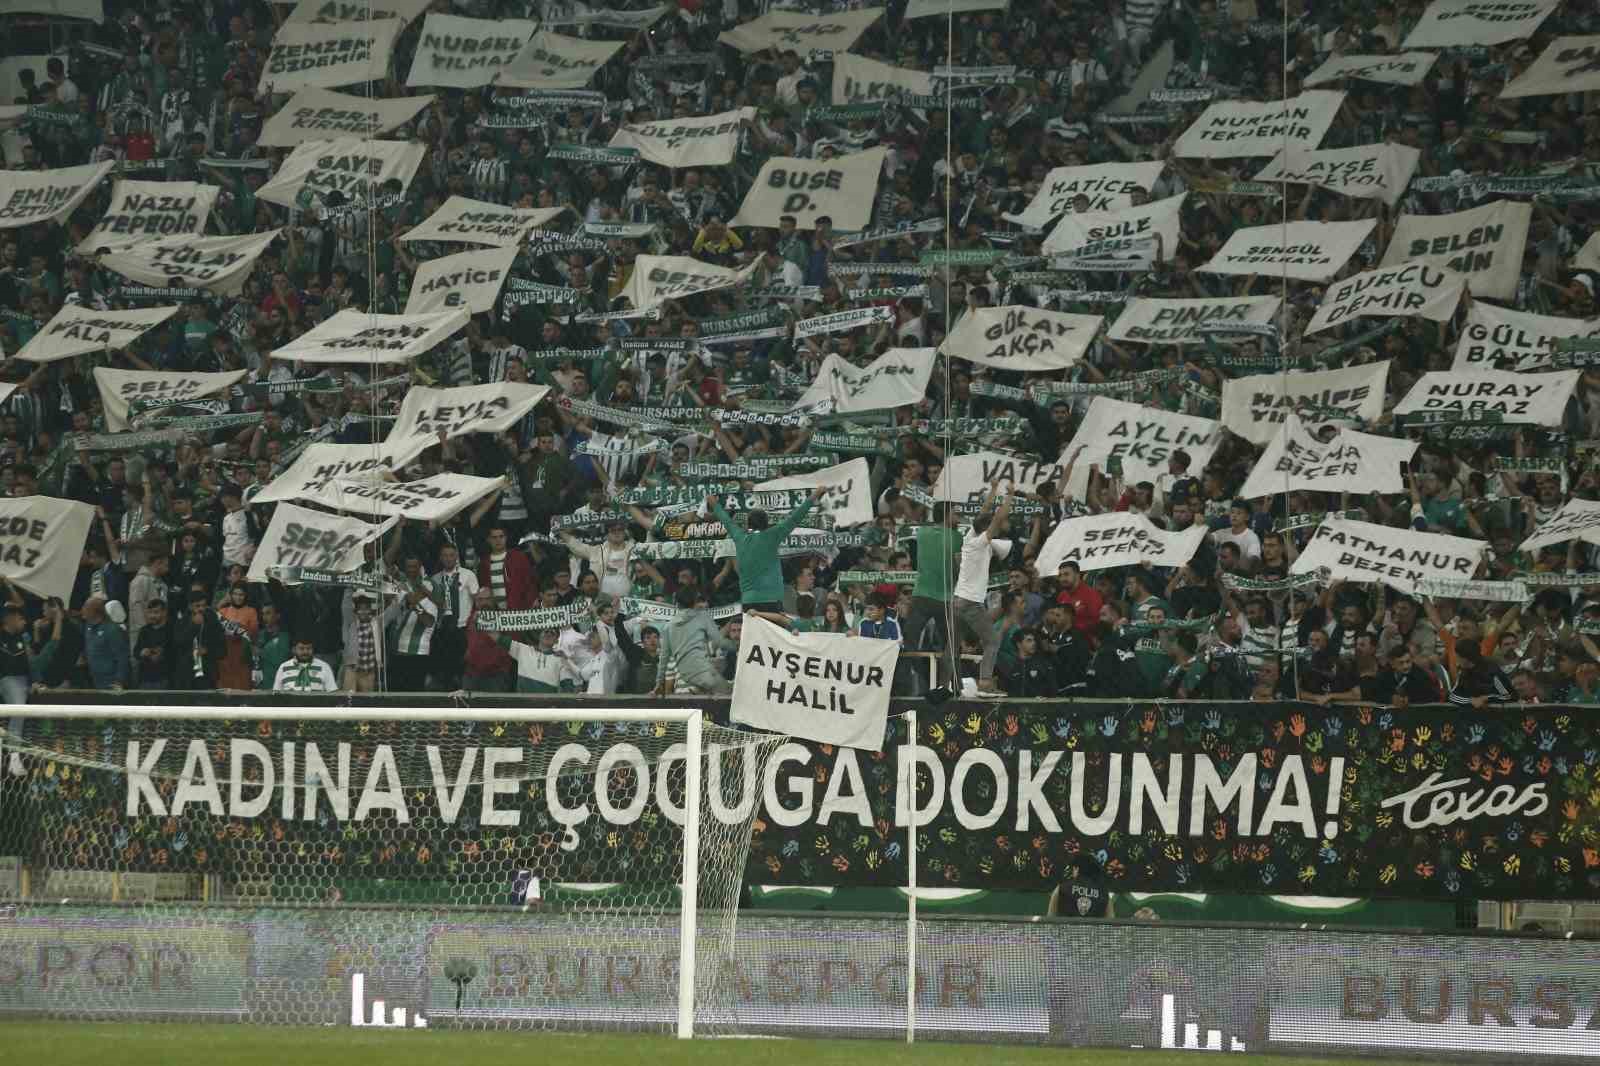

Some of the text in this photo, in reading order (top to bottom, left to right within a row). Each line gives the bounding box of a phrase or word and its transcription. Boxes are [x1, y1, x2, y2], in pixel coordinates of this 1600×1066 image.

[768, 168, 843, 190] BUSE
[1050, 176, 1136, 196] HATİCE
[122, 195, 196, 212] NAZLI
[1409, 225, 1504, 257] SELEN
[420, 267, 501, 294] HATİCE
[1334, 264, 1445, 304] BURCU
[1151, 303, 1250, 325] PINAR
[1326, 286, 1427, 323] DEMİR
[984, 309, 1076, 341] GÜLAY
[986, 333, 1055, 359] AKÇA
[1427, 382, 1543, 399] NURAY
[1108, 420, 1212, 447] AYLİN
[313, 454, 393, 479] HİVDA
[681, 463, 767, 479] BURSASPOR
[1315, 525, 1473, 574] FATMANUR
[500, 610, 566, 627] BURSASPOR
[745, 644, 884, 688] AYŞENUR
[766, 679, 855, 715] HALİL
[125, 737, 410, 825] KADINA
[425, 744, 523, 827] VE
[895, 744, 1346, 841] DOKUNMA!
